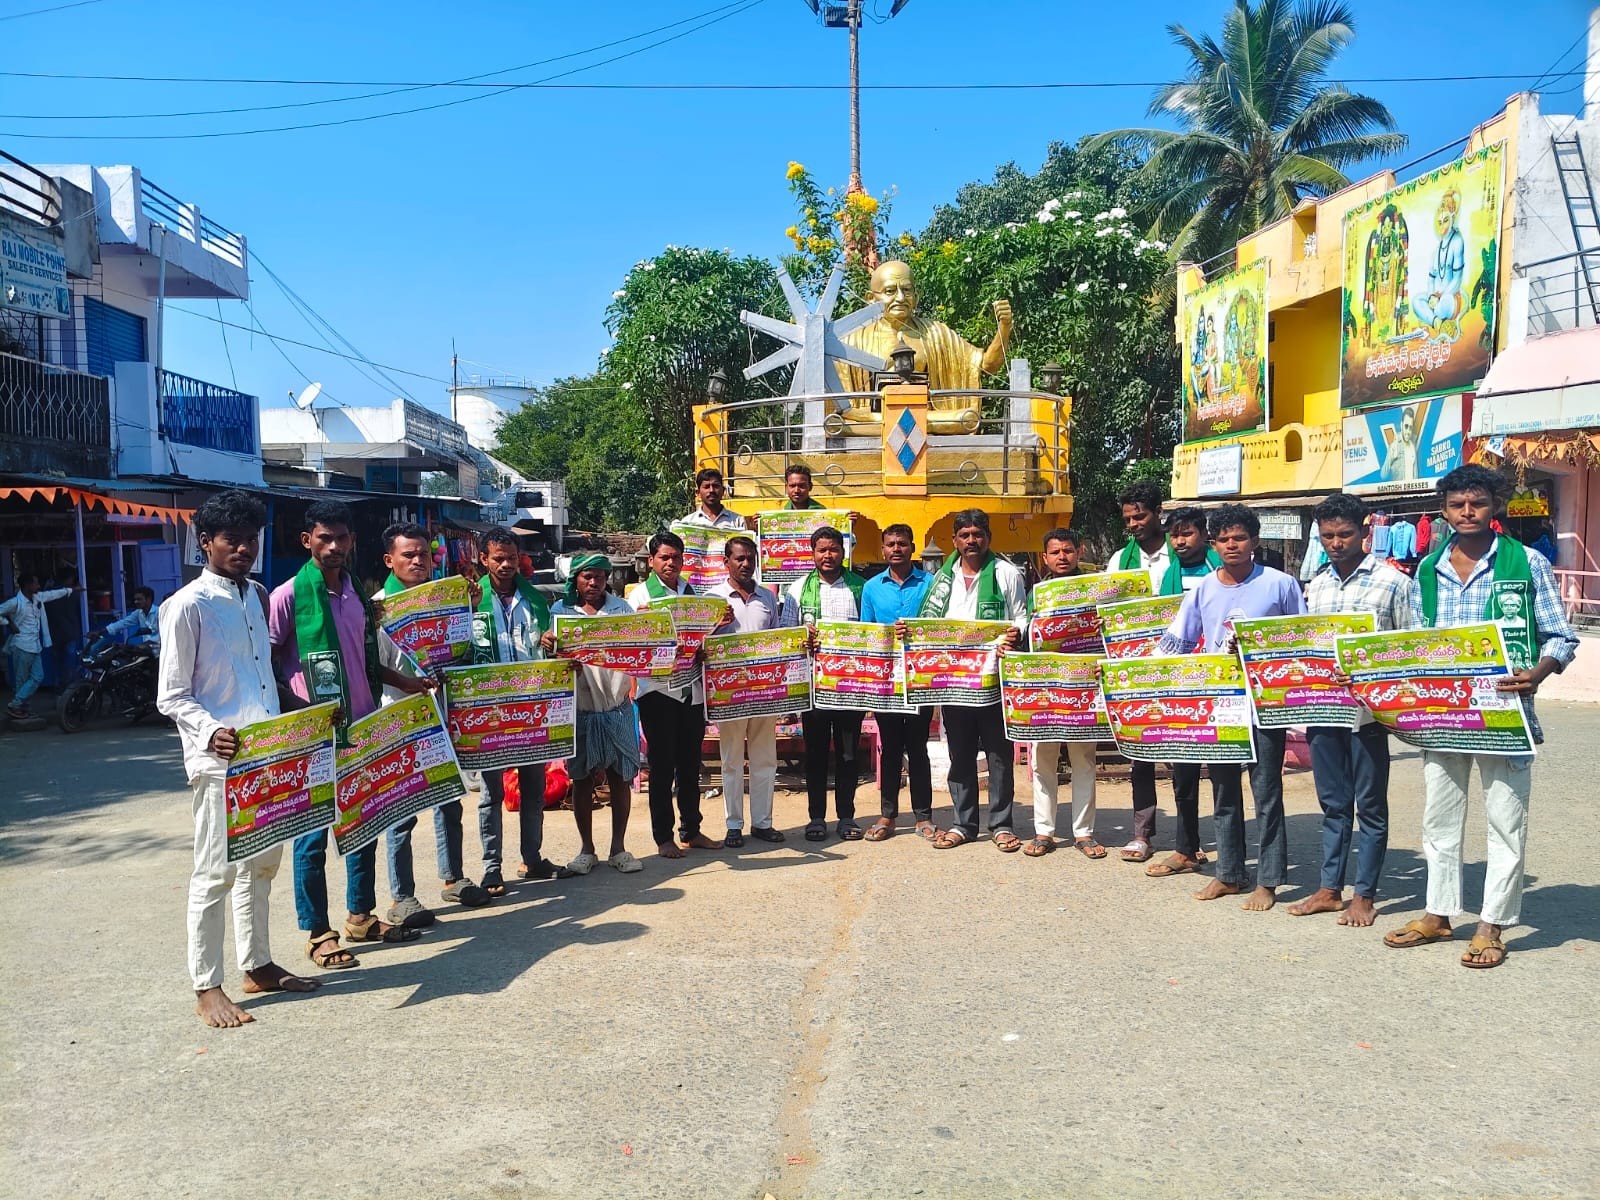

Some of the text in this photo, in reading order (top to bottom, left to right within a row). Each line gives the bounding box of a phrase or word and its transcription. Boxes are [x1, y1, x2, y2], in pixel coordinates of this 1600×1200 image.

[2, 240, 17, 258] RAJ
[18, 244, 45, 266] MOBILE
[46, 252, 65, 272] POINT
[8, 260, 28, 273] SALES
[35, 267, 62, 282] SERVICES
[1347, 437, 1364, 446] LUX
[1431, 440, 1451, 453] SABKO
[1344, 447, 1368, 459] VENUS
[1403, 482, 1429, 490] DRESSES
[451, 616, 459, 626] 23
[657, 648, 668, 657] 23
[790, 662, 799, 670] 23
[1477, 677, 1491, 689] 23
[552, 700, 562, 709] 23
[1219, 697, 1231, 707] 23
[420, 739, 432, 751] 23
[432, 737, 446, 746] 2025
[311, 752, 320, 766] 23
